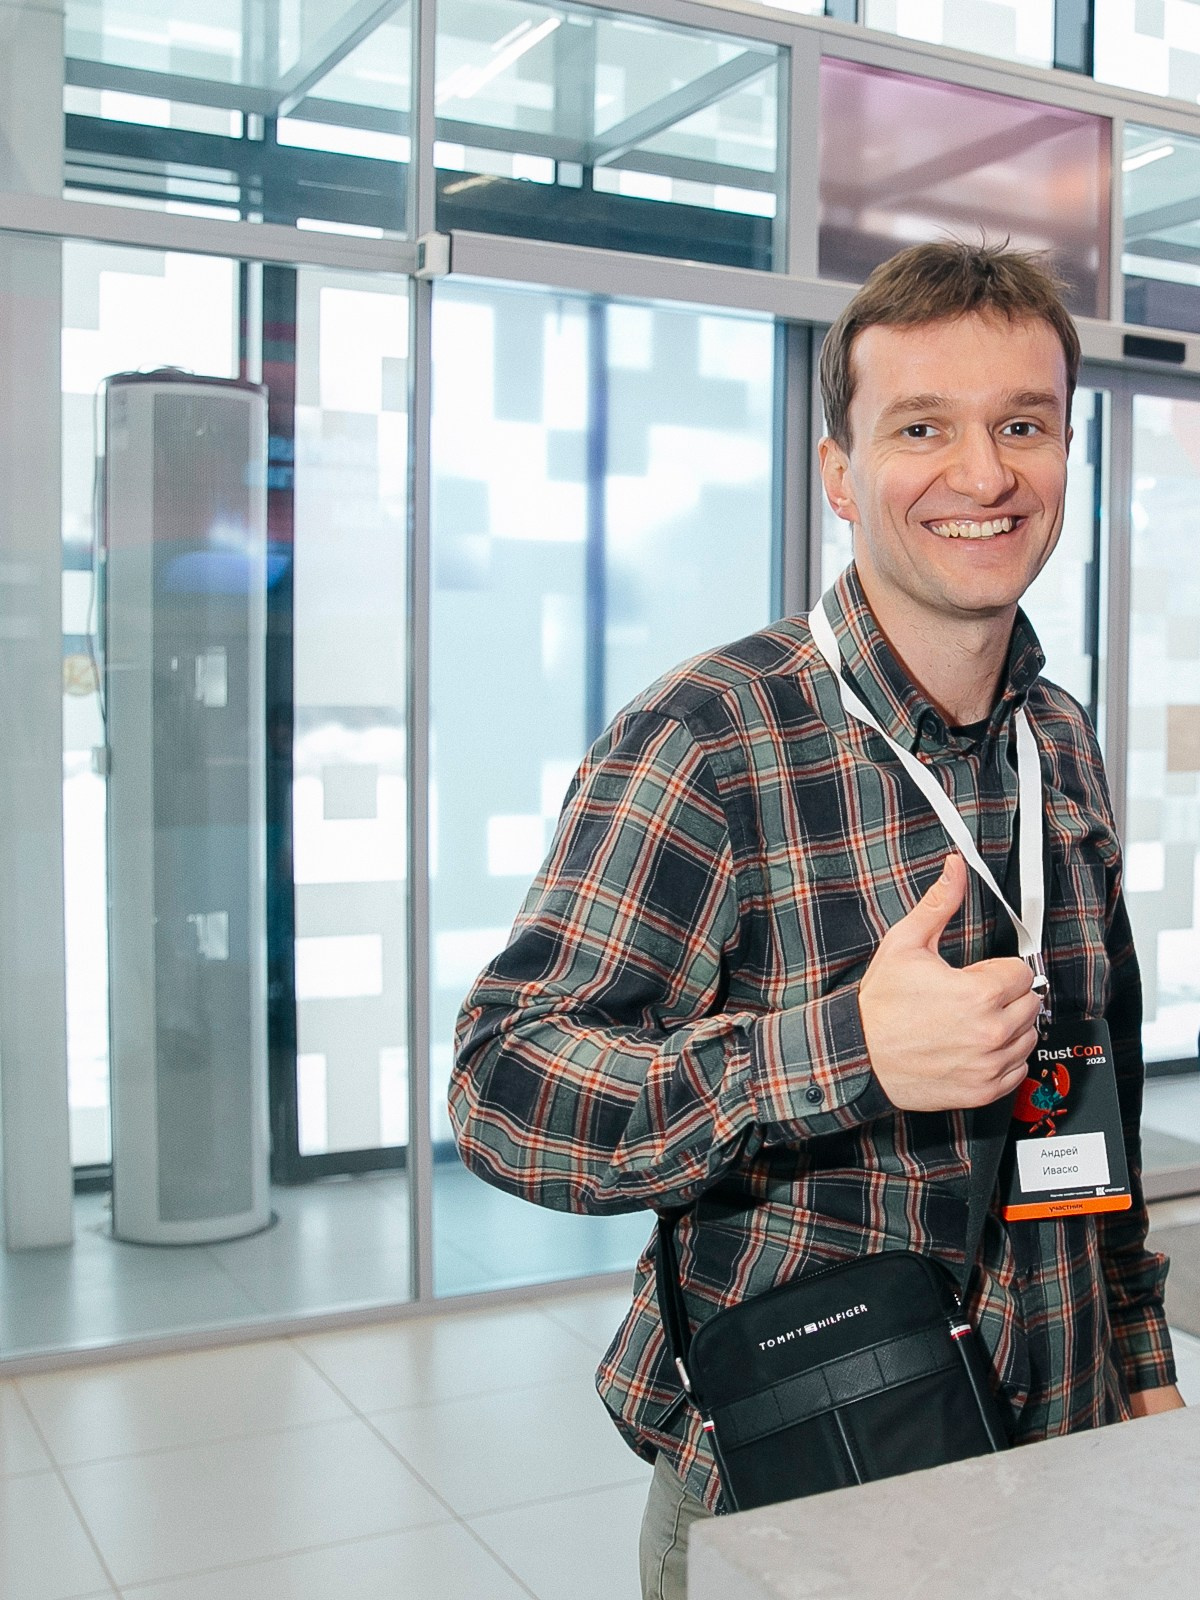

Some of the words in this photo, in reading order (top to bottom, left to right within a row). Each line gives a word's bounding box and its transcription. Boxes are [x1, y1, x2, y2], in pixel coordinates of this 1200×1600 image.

[1037, 1044, 1103, 1061] RustCon
[1086, 1056, 1106, 1065] 2023
[1040, 1146, 1078, 1160] Андрей
[1042, 1165, 1079, 1176] Иваско
[759, 1327, 802, 1351] TOMMY
[818, 1303, 868, 1329] HILFIGER
